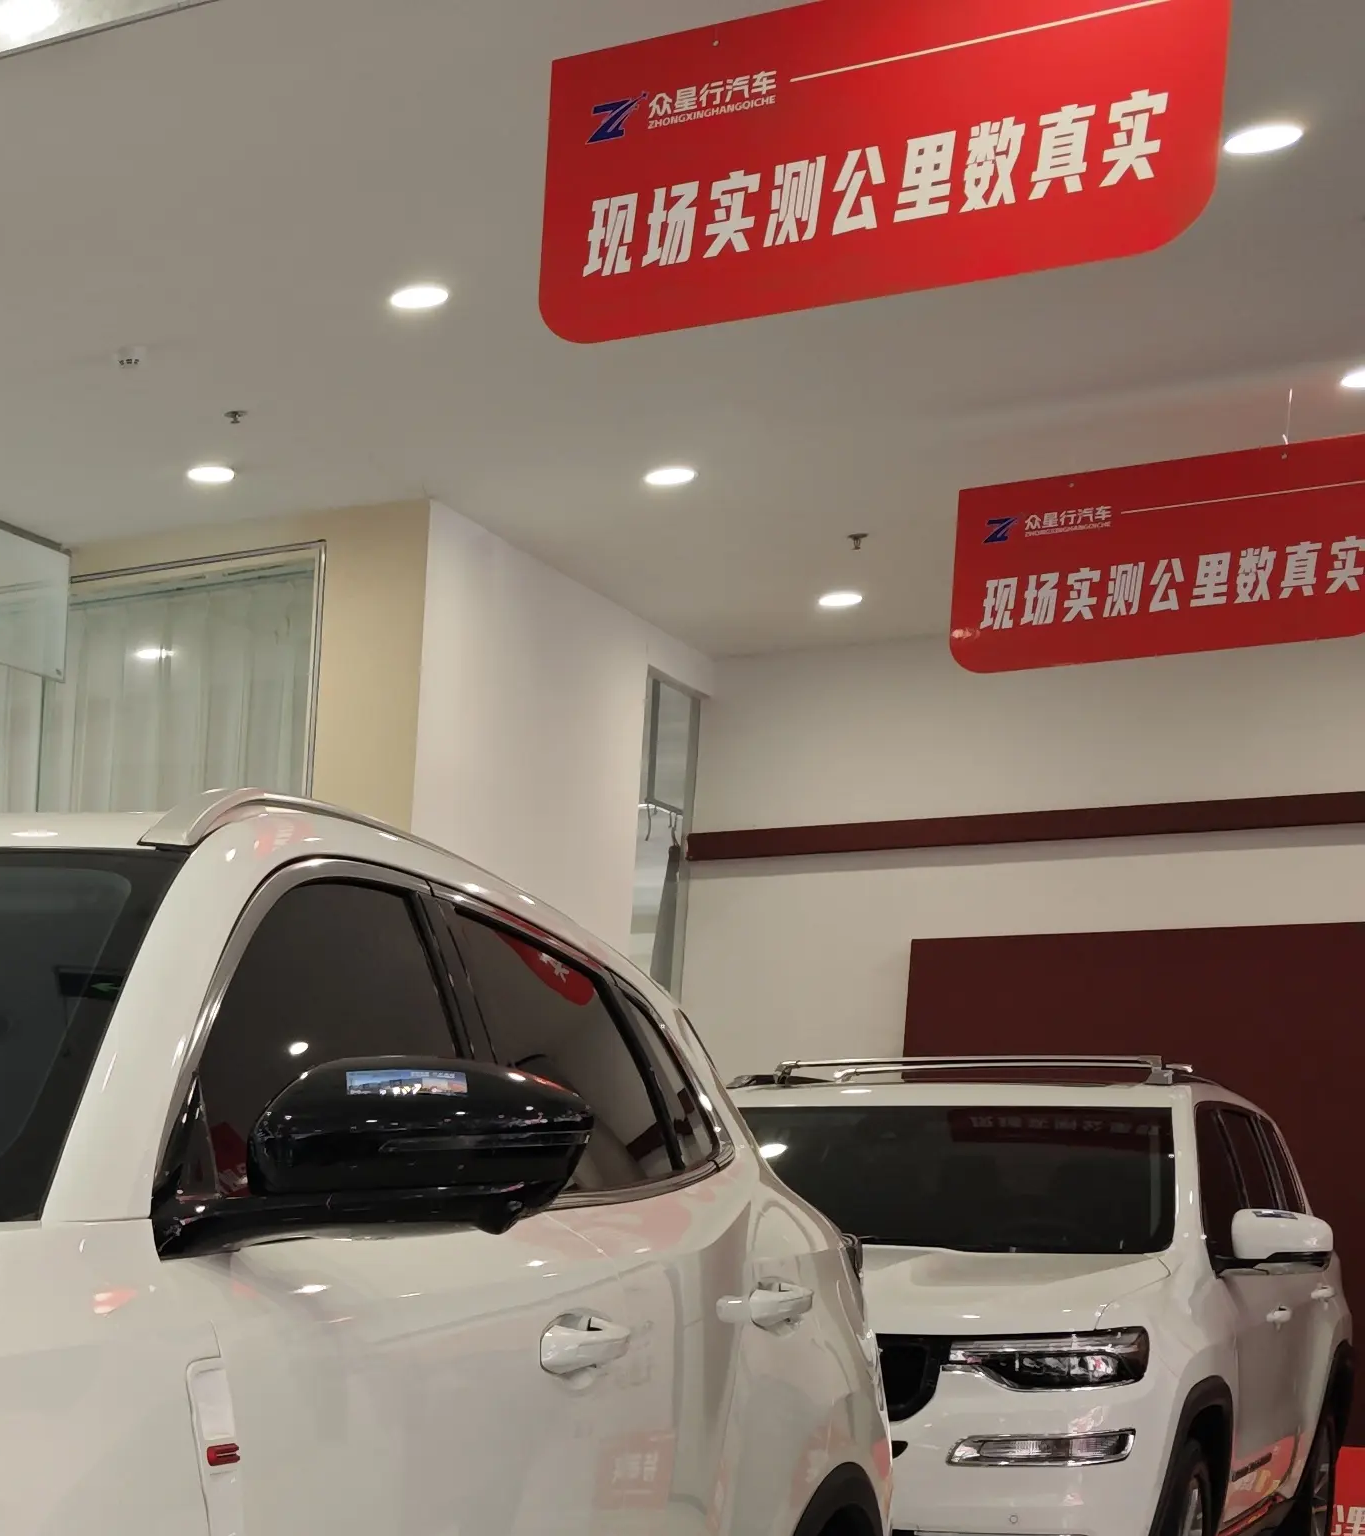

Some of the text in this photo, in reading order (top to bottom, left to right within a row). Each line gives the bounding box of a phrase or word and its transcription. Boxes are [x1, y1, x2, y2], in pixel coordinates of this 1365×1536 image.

[648, 70, 777, 119] 众星行汽车
[582, 89, 1169, 277] 现场实测公里数真实
[1024, 505, 1112, 531] 众星行汽车
[979, 535, 1365, 630] 现场实测公里数真实
